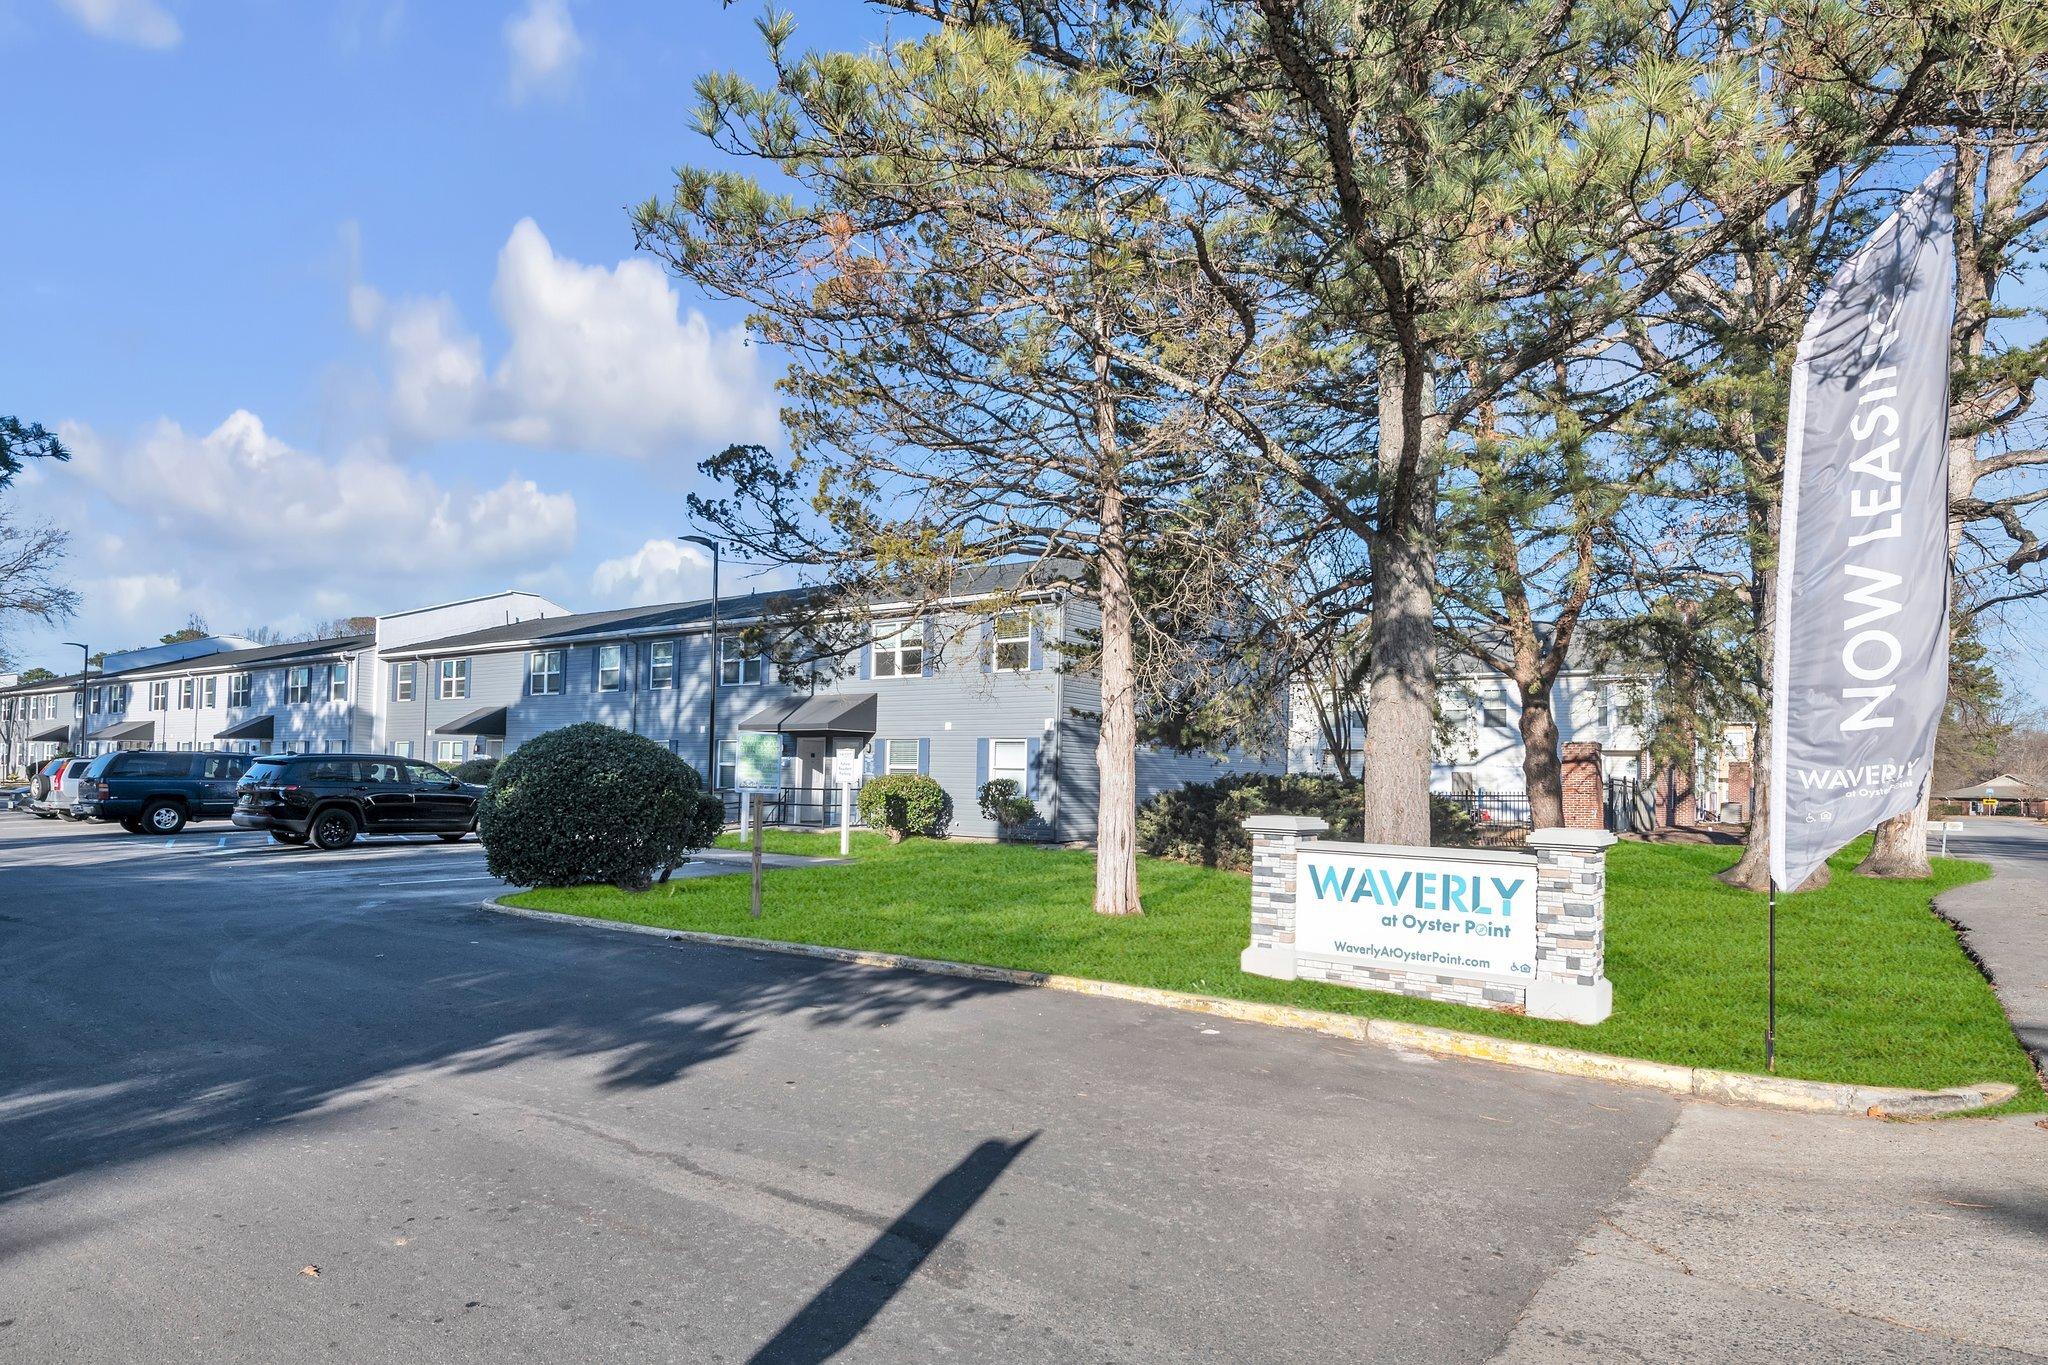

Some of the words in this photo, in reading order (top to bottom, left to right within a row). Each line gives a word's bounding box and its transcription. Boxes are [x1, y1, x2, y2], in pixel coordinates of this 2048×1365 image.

[1839, 563, 1903, 732] NOW
[1845, 789, 1857, 798] at
[1859, 785, 1891, 798] Oyste
[1308, 864, 1525, 917] WAVERLY
[1381, 914, 1398, 927] at
[1402, 914, 1460, 934] Oyster
[1465, 919, 1512, 938] Point
[1334, 940, 1491, 969] WaverlyAtOysterPoint.com
